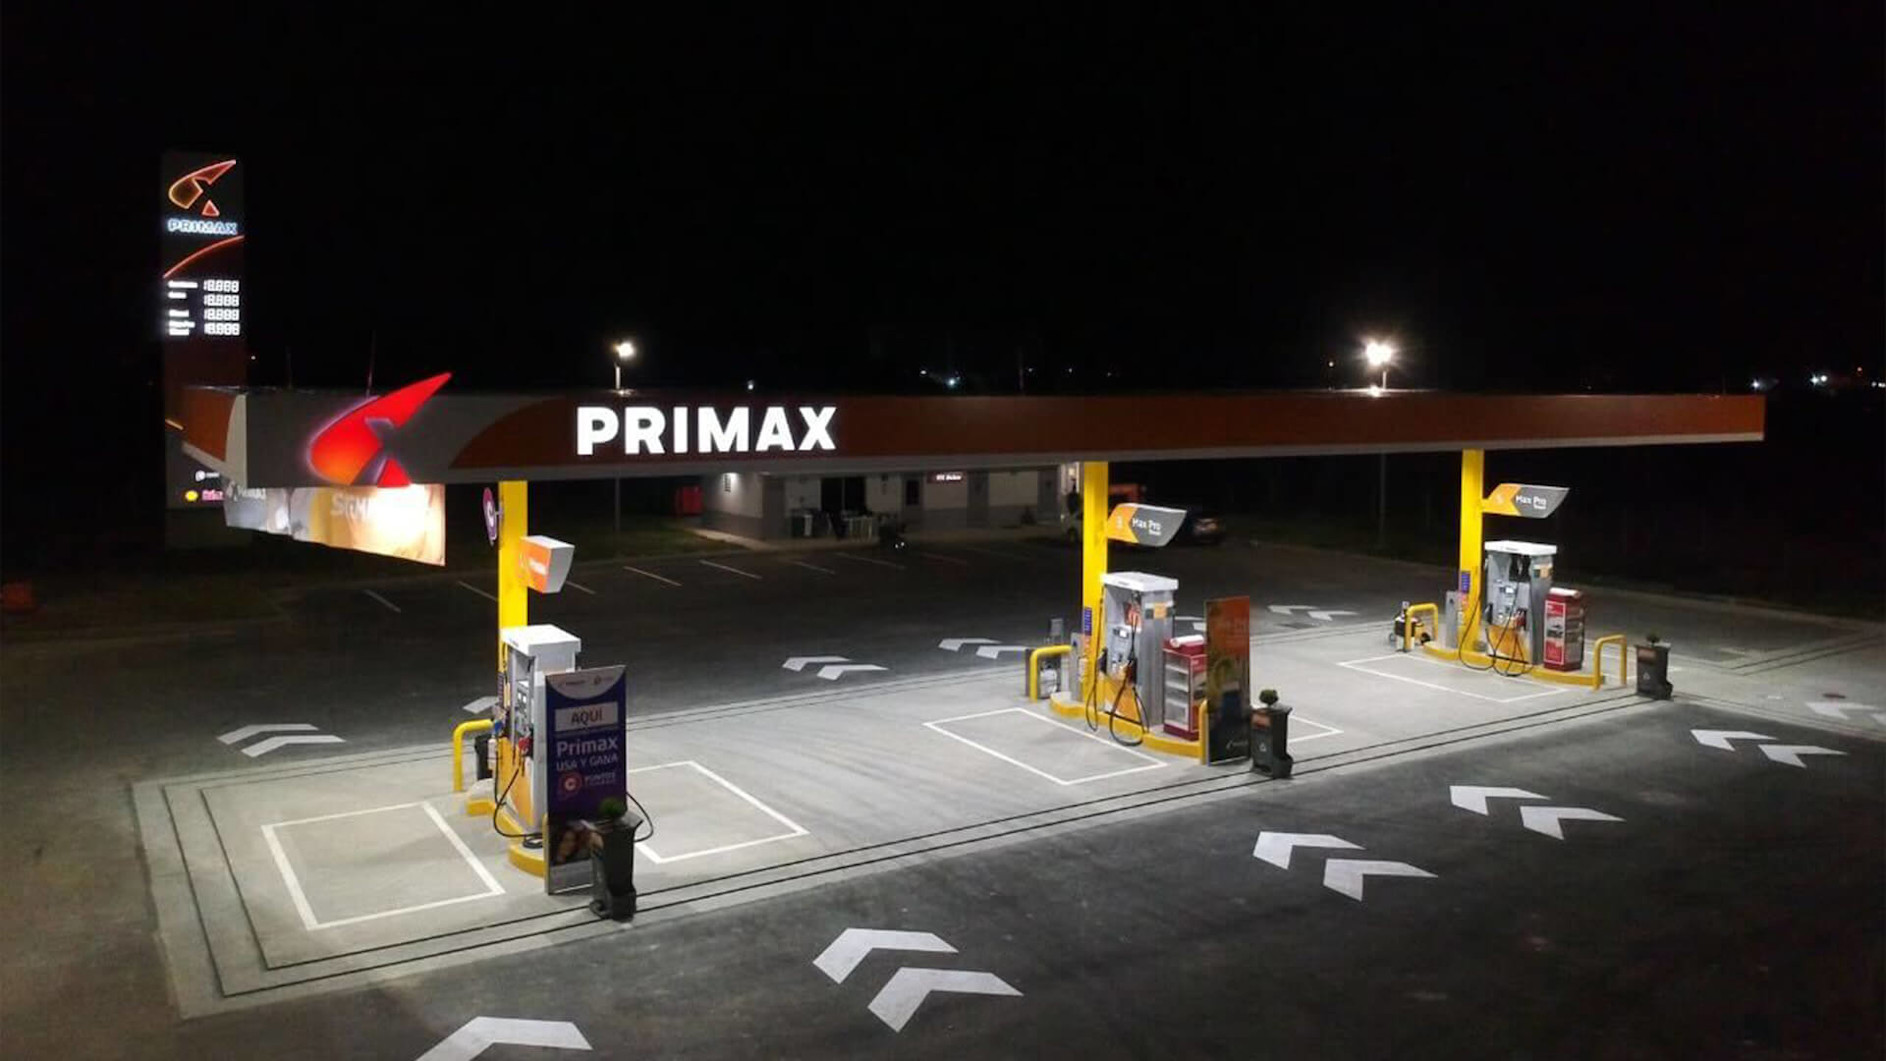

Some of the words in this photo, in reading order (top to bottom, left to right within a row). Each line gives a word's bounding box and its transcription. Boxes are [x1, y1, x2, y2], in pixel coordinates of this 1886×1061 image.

[168, 218, 237, 236] PRIMAX
[577, 406, 837, 456] PRIMAX
[557, 737, 618, 756] Primax
[556, 760, 578, 772] USA
[589, 754, 618, 767] GANA
